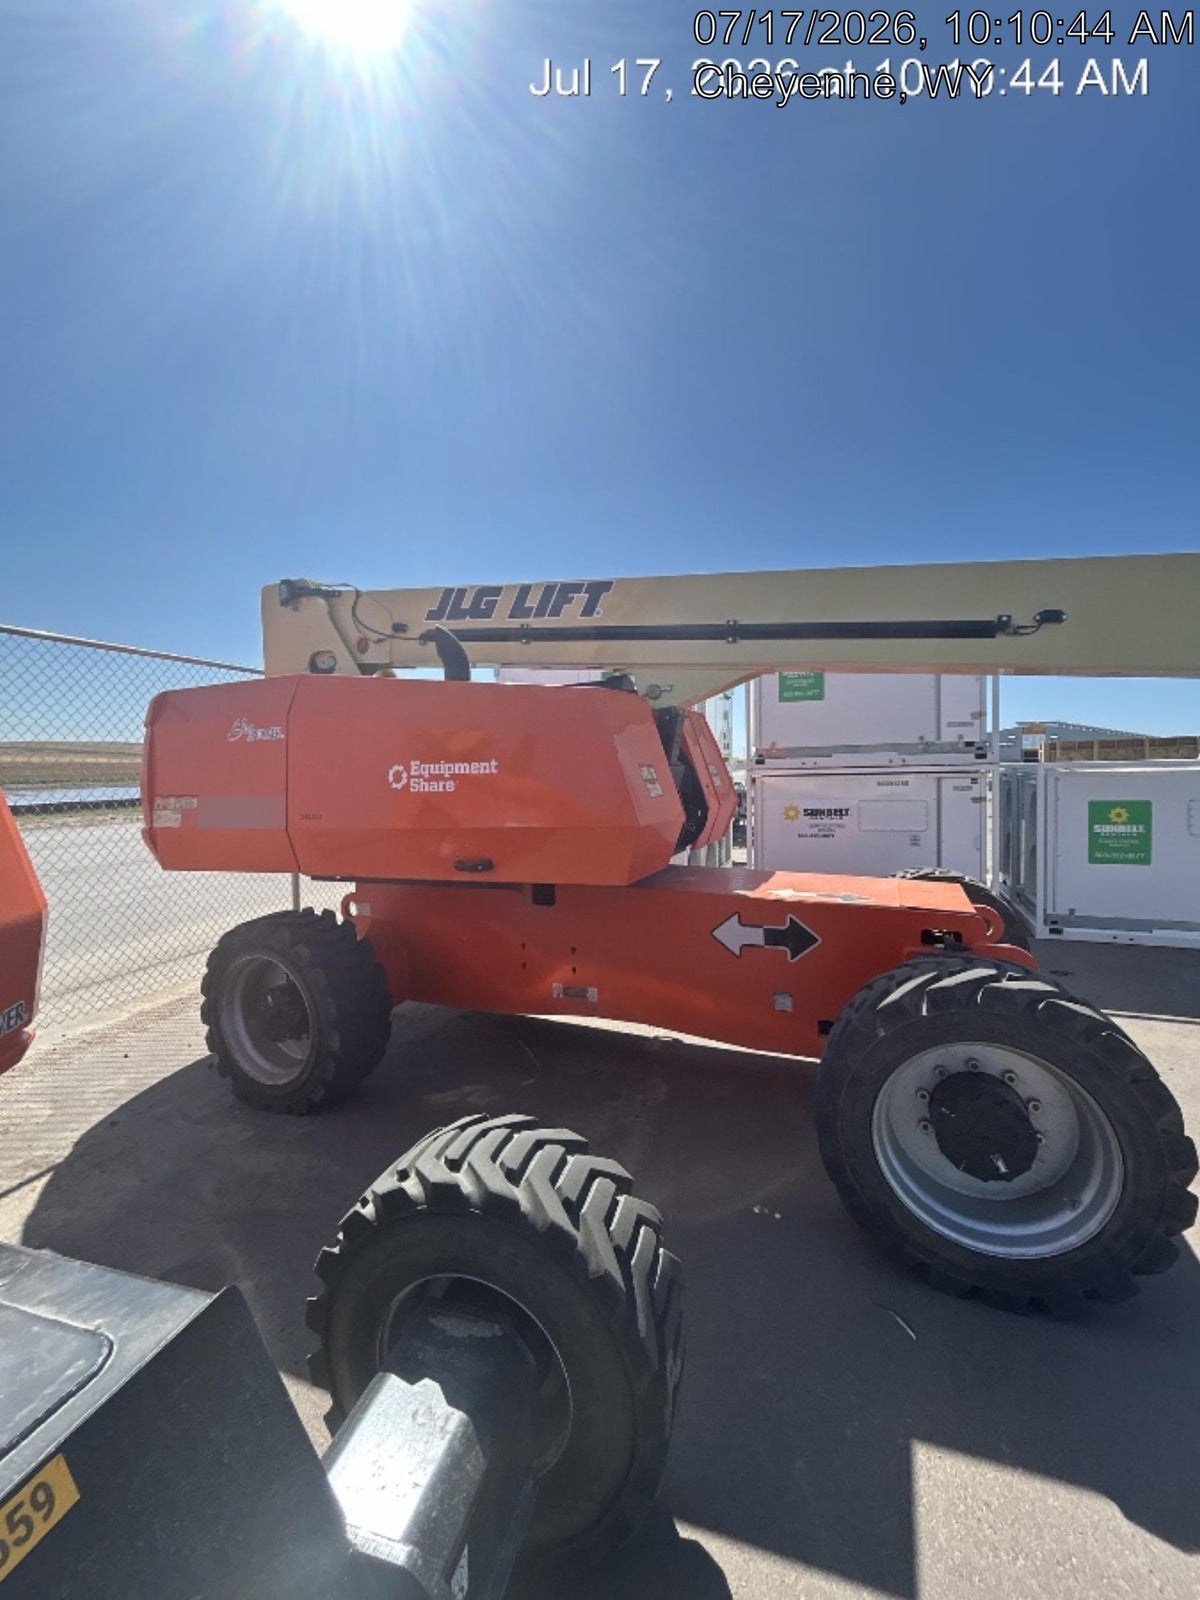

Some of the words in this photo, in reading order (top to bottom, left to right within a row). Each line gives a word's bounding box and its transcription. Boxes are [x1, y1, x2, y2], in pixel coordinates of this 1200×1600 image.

[424, 586, 504, 622] JLG
[506, 580, 616, 621] LIFT
[410, 759, 498, 778] Equipment
[410, 779, 455, 792] Share
[803, 808, 850, 817] SUNBELT
